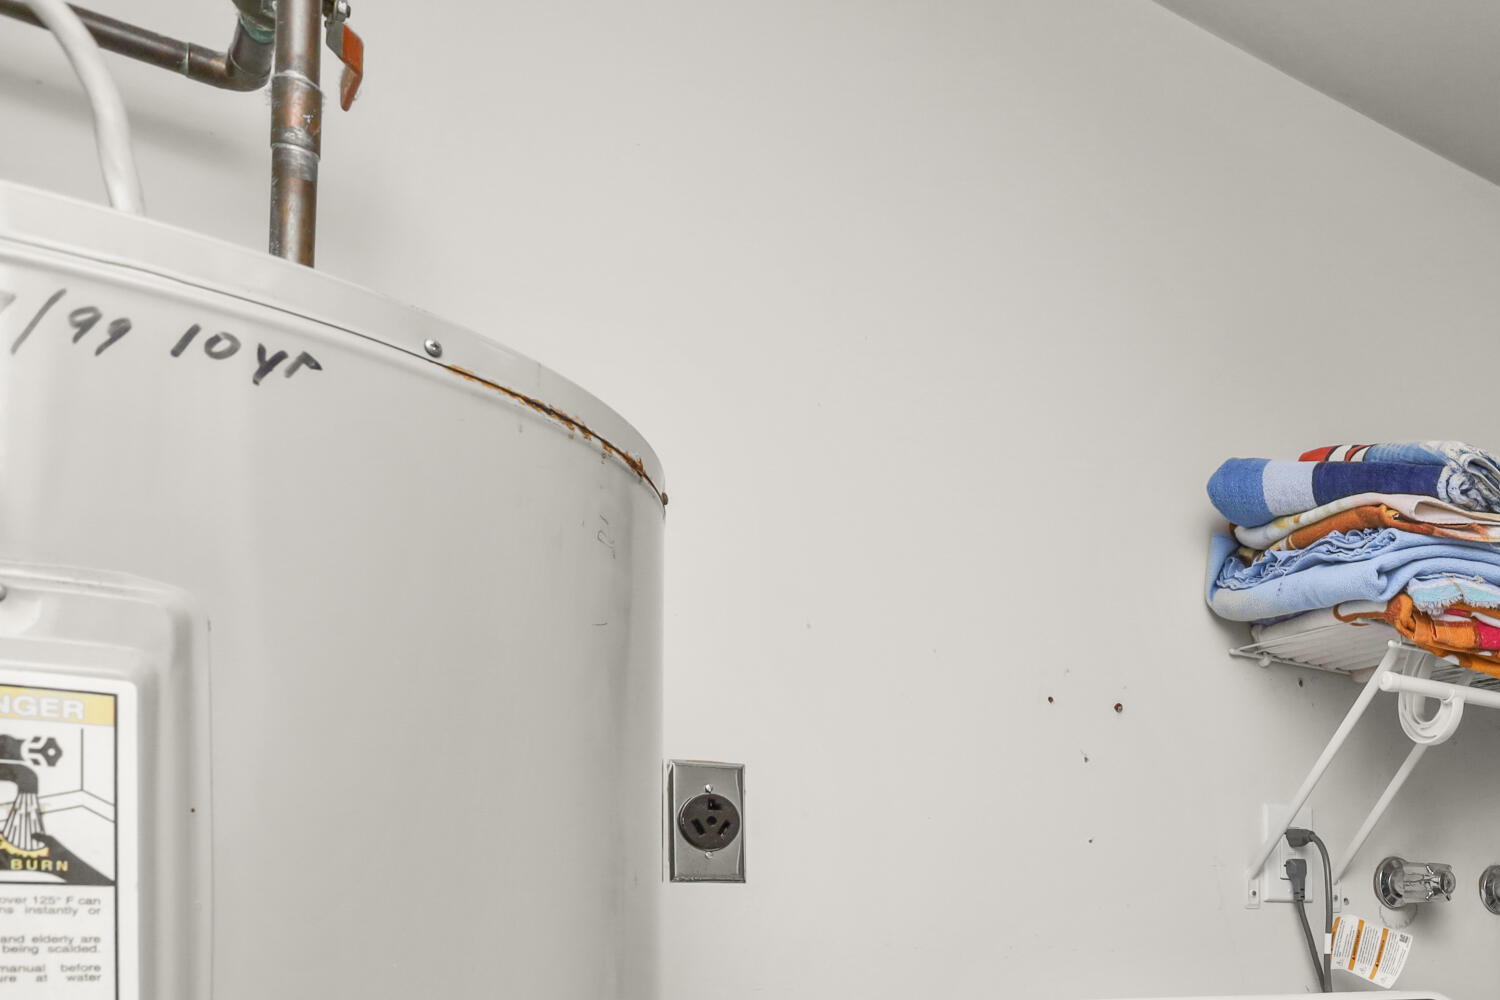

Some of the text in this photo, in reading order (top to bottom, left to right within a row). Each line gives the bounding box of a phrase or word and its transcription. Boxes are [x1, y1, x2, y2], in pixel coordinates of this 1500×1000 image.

[10, 858, 69, 871] BURN
[25, 906, 78, 917] instantly
[32, 935, 74, 945] elderly
[2, 945, 39, 955] being
[60, 963, 102, 972] before
[66, 974, 103, 982] water
